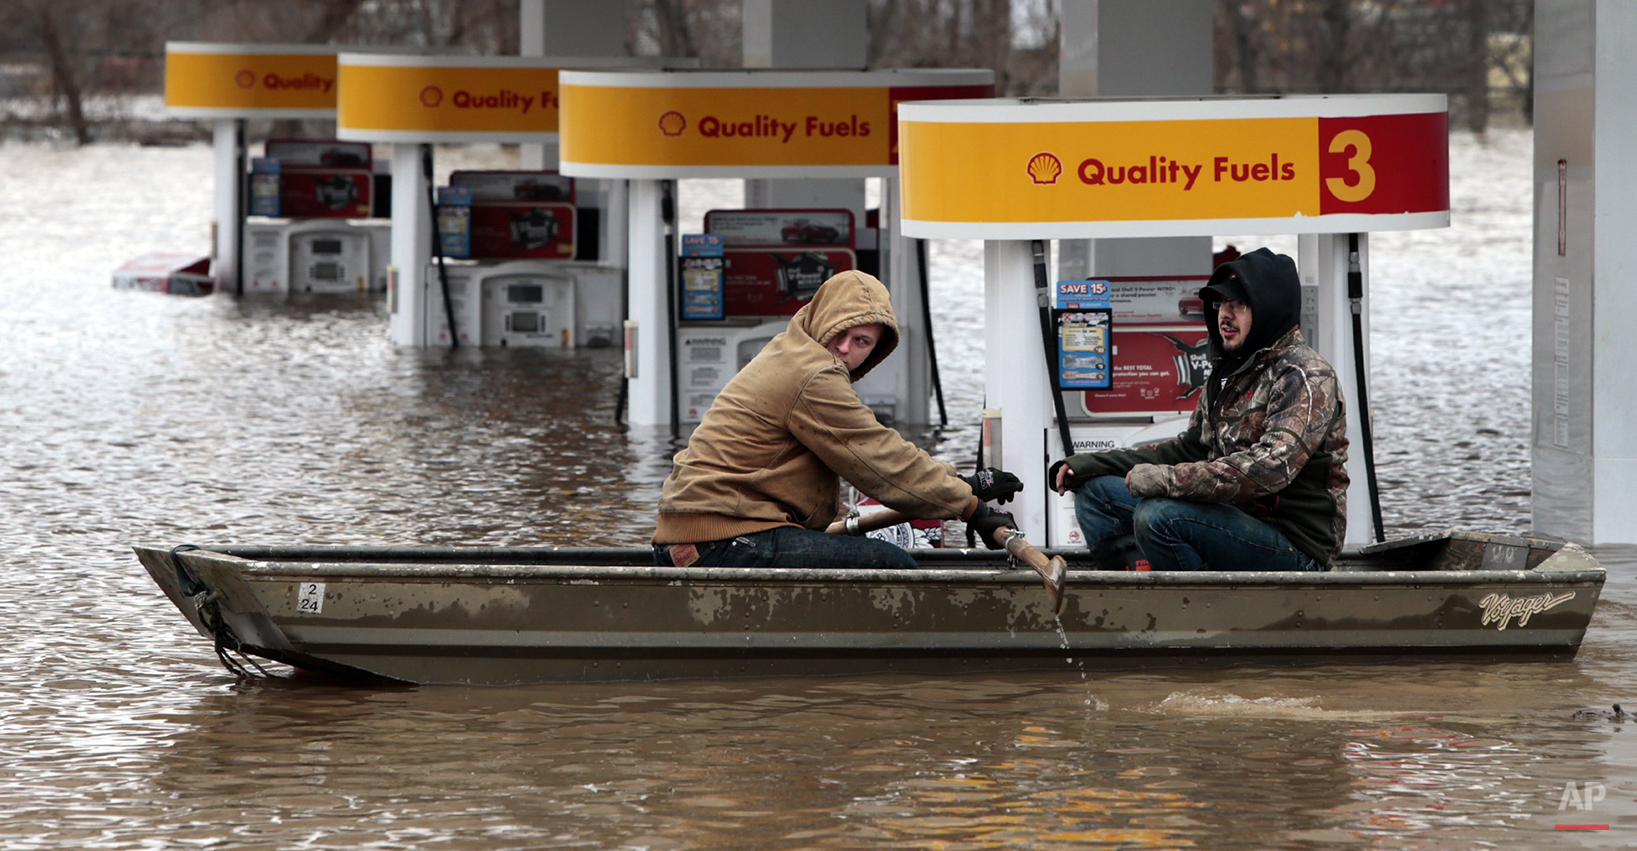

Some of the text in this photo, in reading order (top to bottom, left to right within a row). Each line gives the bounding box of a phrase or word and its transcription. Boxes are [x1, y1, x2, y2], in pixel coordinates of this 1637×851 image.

[264, 73, 333, 94] Quality
[453, 89, 534, 114] Quality
[698, 115, 797, 143] Quality
[806, 115, 870, 137] Fuels
[1078, 153, 1295, 191] Quality Fuels
[1325, 129, 1376, 202] 3
[1060, 286, 1088, 296] SAVE
[1073, 440, 1115, 448] WARNING
[308, 584, 317, 595] 2
[301, 599, 318, 611] 24
[1478, 590, 1576, 631] Voyager
